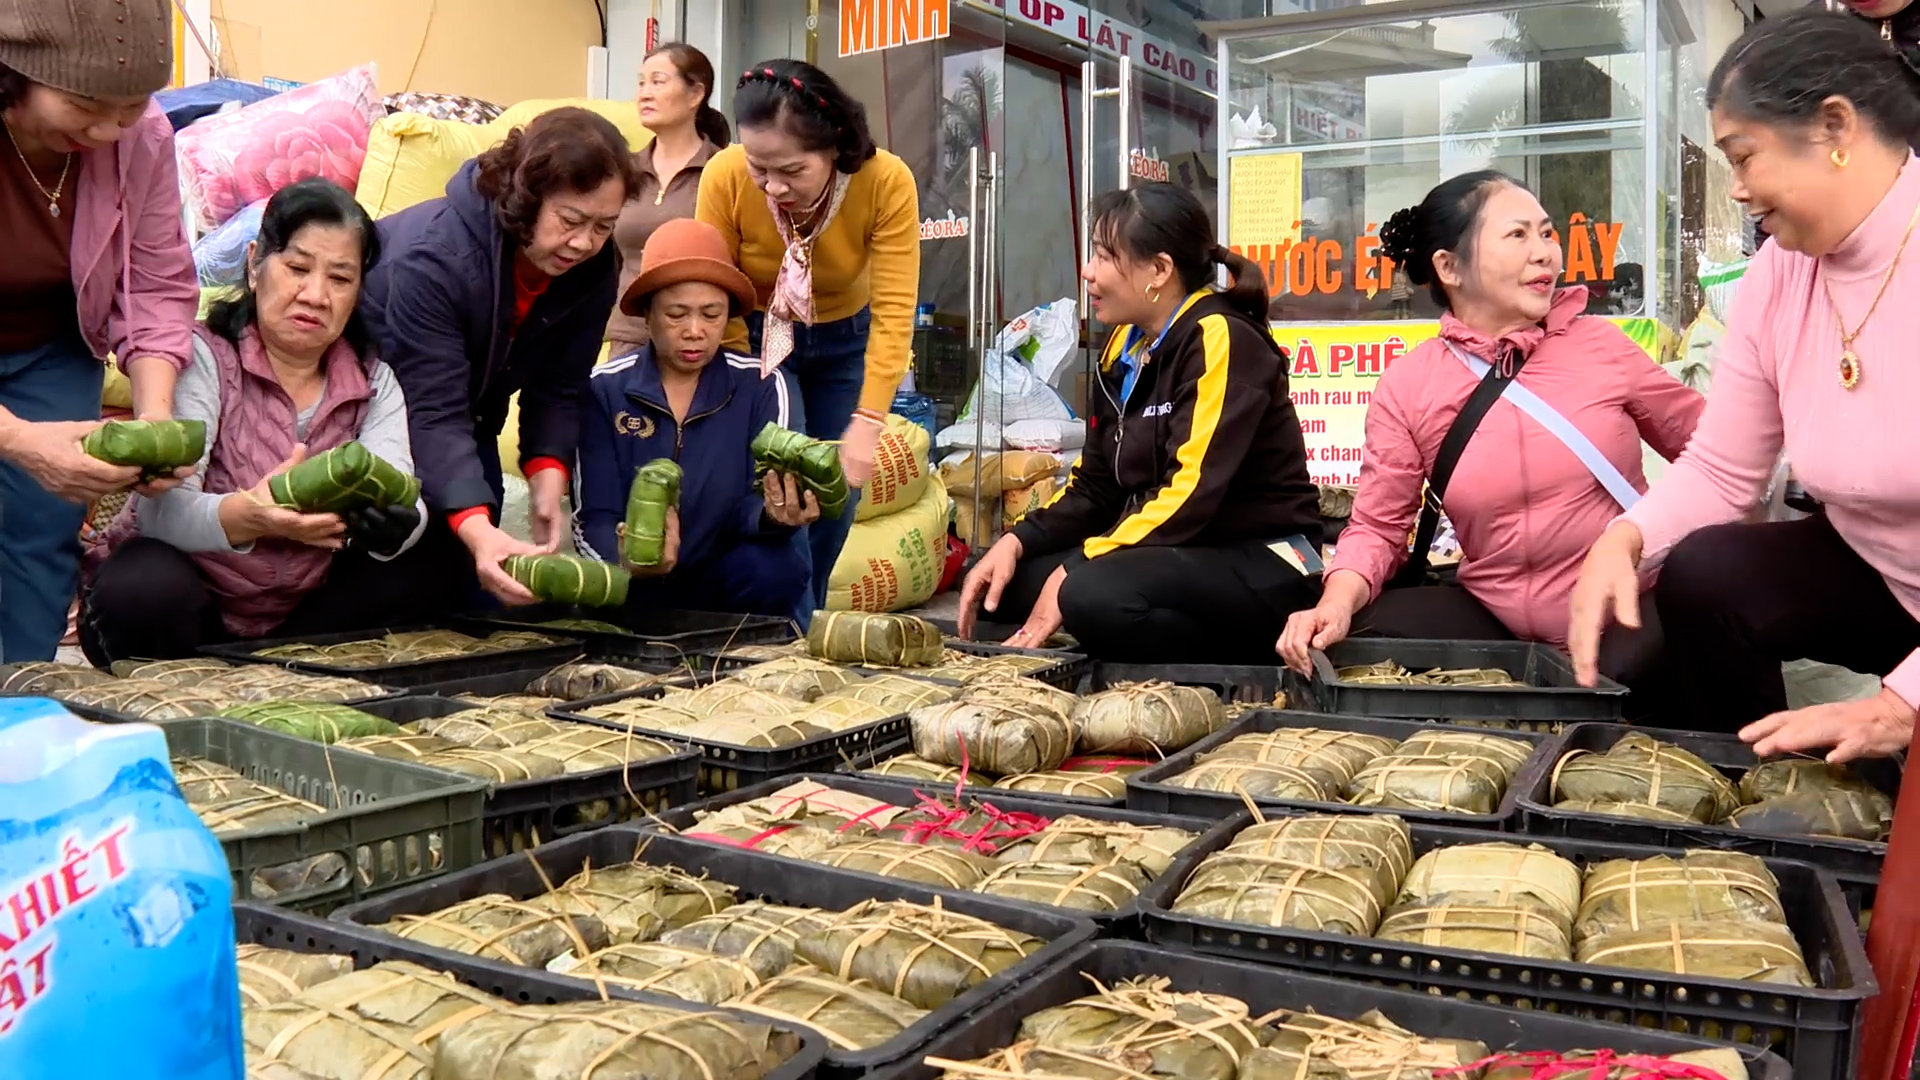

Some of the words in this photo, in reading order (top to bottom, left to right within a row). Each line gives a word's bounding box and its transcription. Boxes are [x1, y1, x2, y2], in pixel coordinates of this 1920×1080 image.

[1078, 15, 1132, 56] LÁT
[1143, 42, 1196, 82] CAO
[1296, 106, 1339, 139] HIẾT
[1552, 212, 1624, 283] ÂY
[1290, 389, 1319, 405] anh
[1325, 391, 1351, 405] rau
[1300, 419, 1326, 433] am
[1320, 444, 1362, 461] chan
[876, 441, 897, 504] PROPYLENE
[1311, 473, 1341, 485] anh
[850, 583, 863, 612] XBPP
[0, 943, 53, 1032] ẬT
